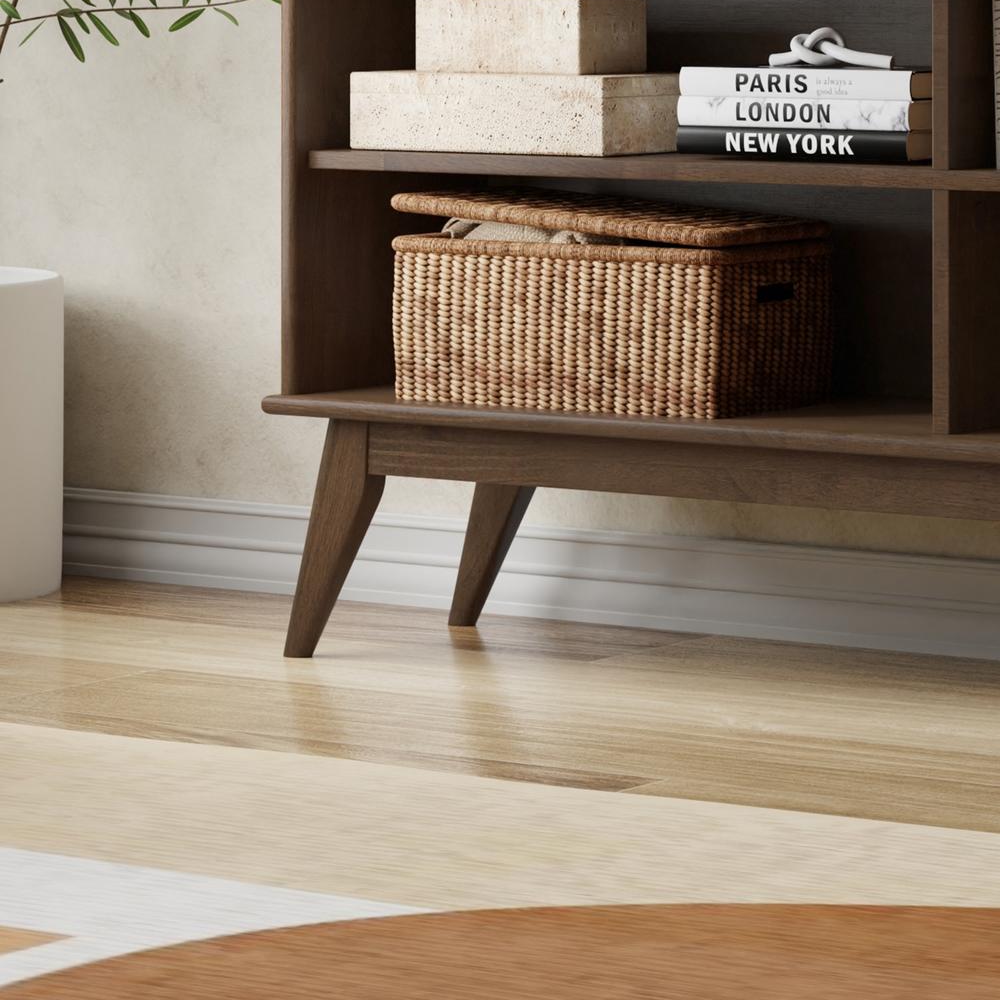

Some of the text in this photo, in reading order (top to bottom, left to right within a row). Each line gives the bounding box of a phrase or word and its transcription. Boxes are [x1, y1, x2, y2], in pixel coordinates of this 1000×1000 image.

[735, 73, 808, 93] PARIS
[823, 76, 847, 91] always
[816, 86, 849, 97] good idea
[735, 101, 831, 123] LONDON
[725, 132, 855, 155] NEW YORK
